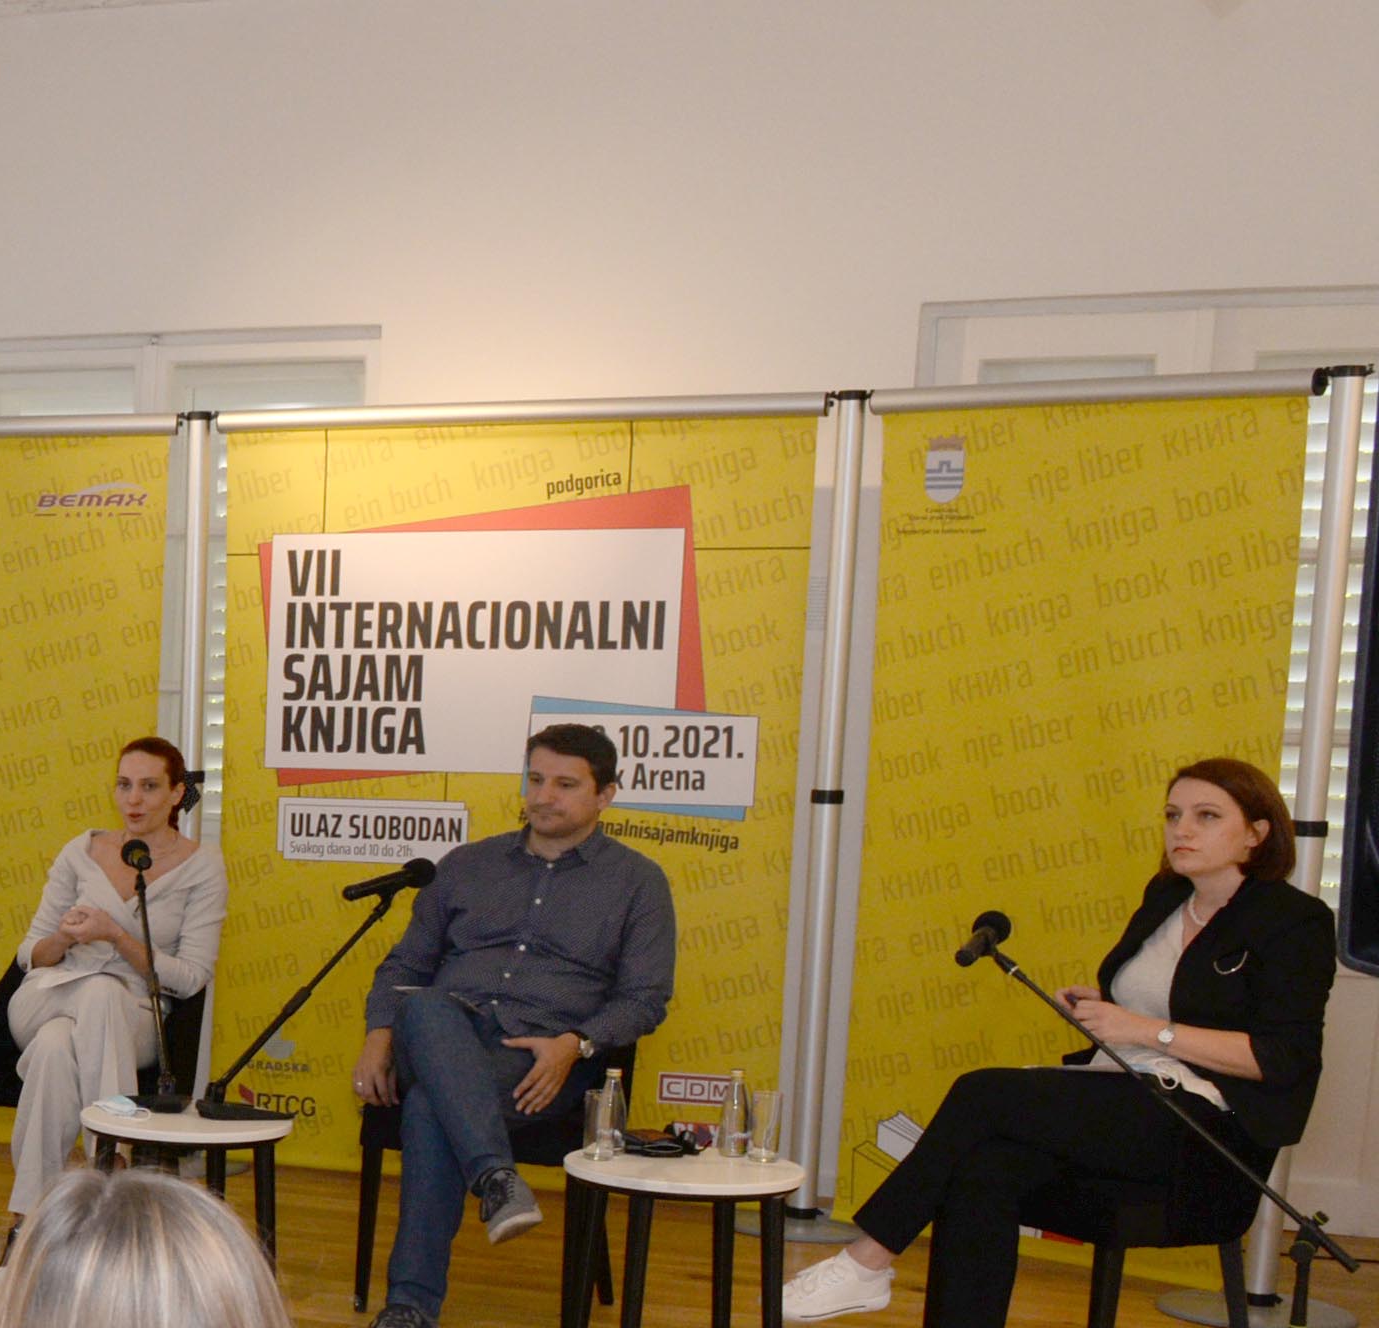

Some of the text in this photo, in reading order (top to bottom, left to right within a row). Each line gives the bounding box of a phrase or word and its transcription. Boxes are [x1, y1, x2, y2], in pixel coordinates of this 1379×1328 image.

[546, 468, 623, 500] podgorica
[37, 494, 148, 508] BEMAX
[694, 508, 727, 543] in
[287, 549, 342, 597] VII
[284, 600, 667, 652] INTERNACIONALNI
[283, 653, 424, 702] SAJAM
[281, 705, 426, 756] KNJIGA
[597, 725, 744, 760] 10.2021.
[631, 762, 706, 791] Arena
[291, 813, 463, 843] ULAZ SLOBODAN
[290, 841, 415, 858] Svakog dana od 10 do 21h.
[256, 1092, 316, 1118] RTCG
[666, 1081, 729, 1098] CDM
